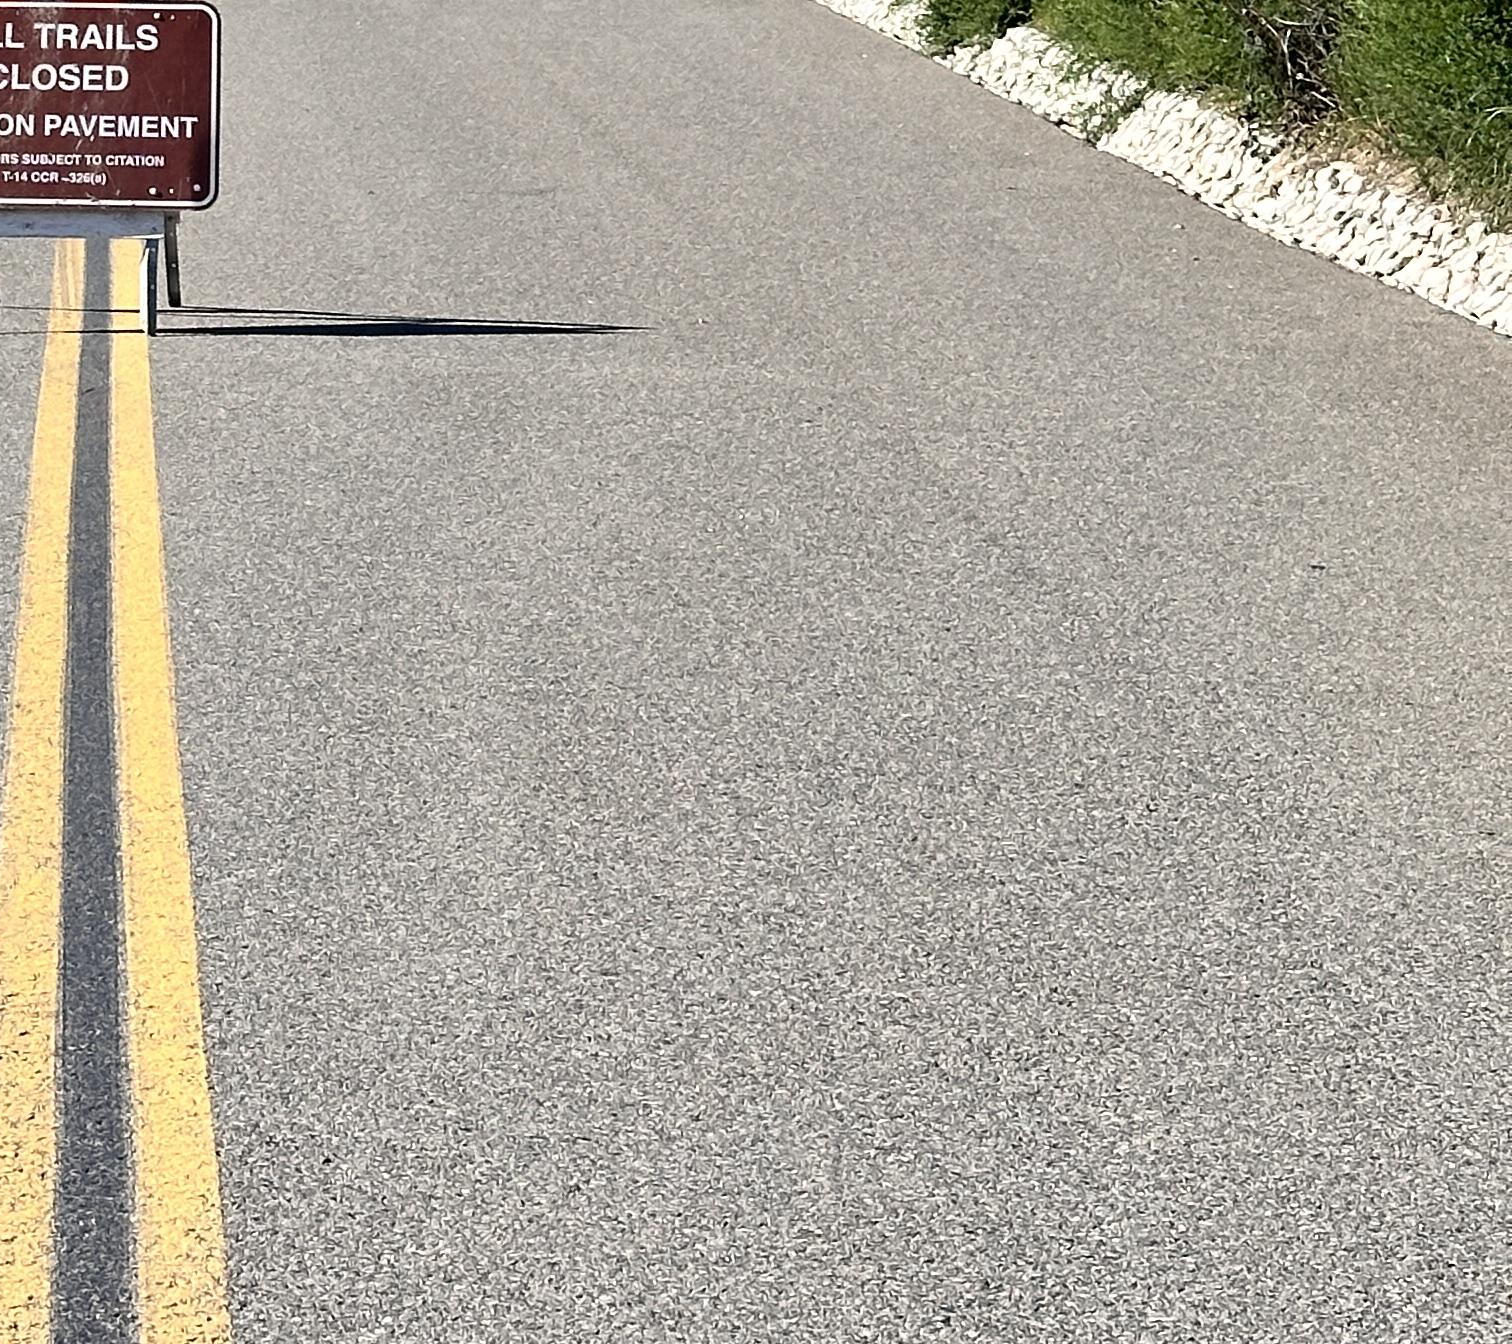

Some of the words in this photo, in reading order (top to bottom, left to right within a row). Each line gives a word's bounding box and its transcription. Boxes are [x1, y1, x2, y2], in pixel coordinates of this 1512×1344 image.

[34, 23, 160, 51] TRAILS
[44, 114, 199, 139] PAVEMENT
[21, 153, 81, 166] SUBJECT
[84, 154, 103, 166] TO
[105, 155, 165, 167] CITATION
[2, 171, 29, 183] T-14
[30, 171, 59, 184] CCR
